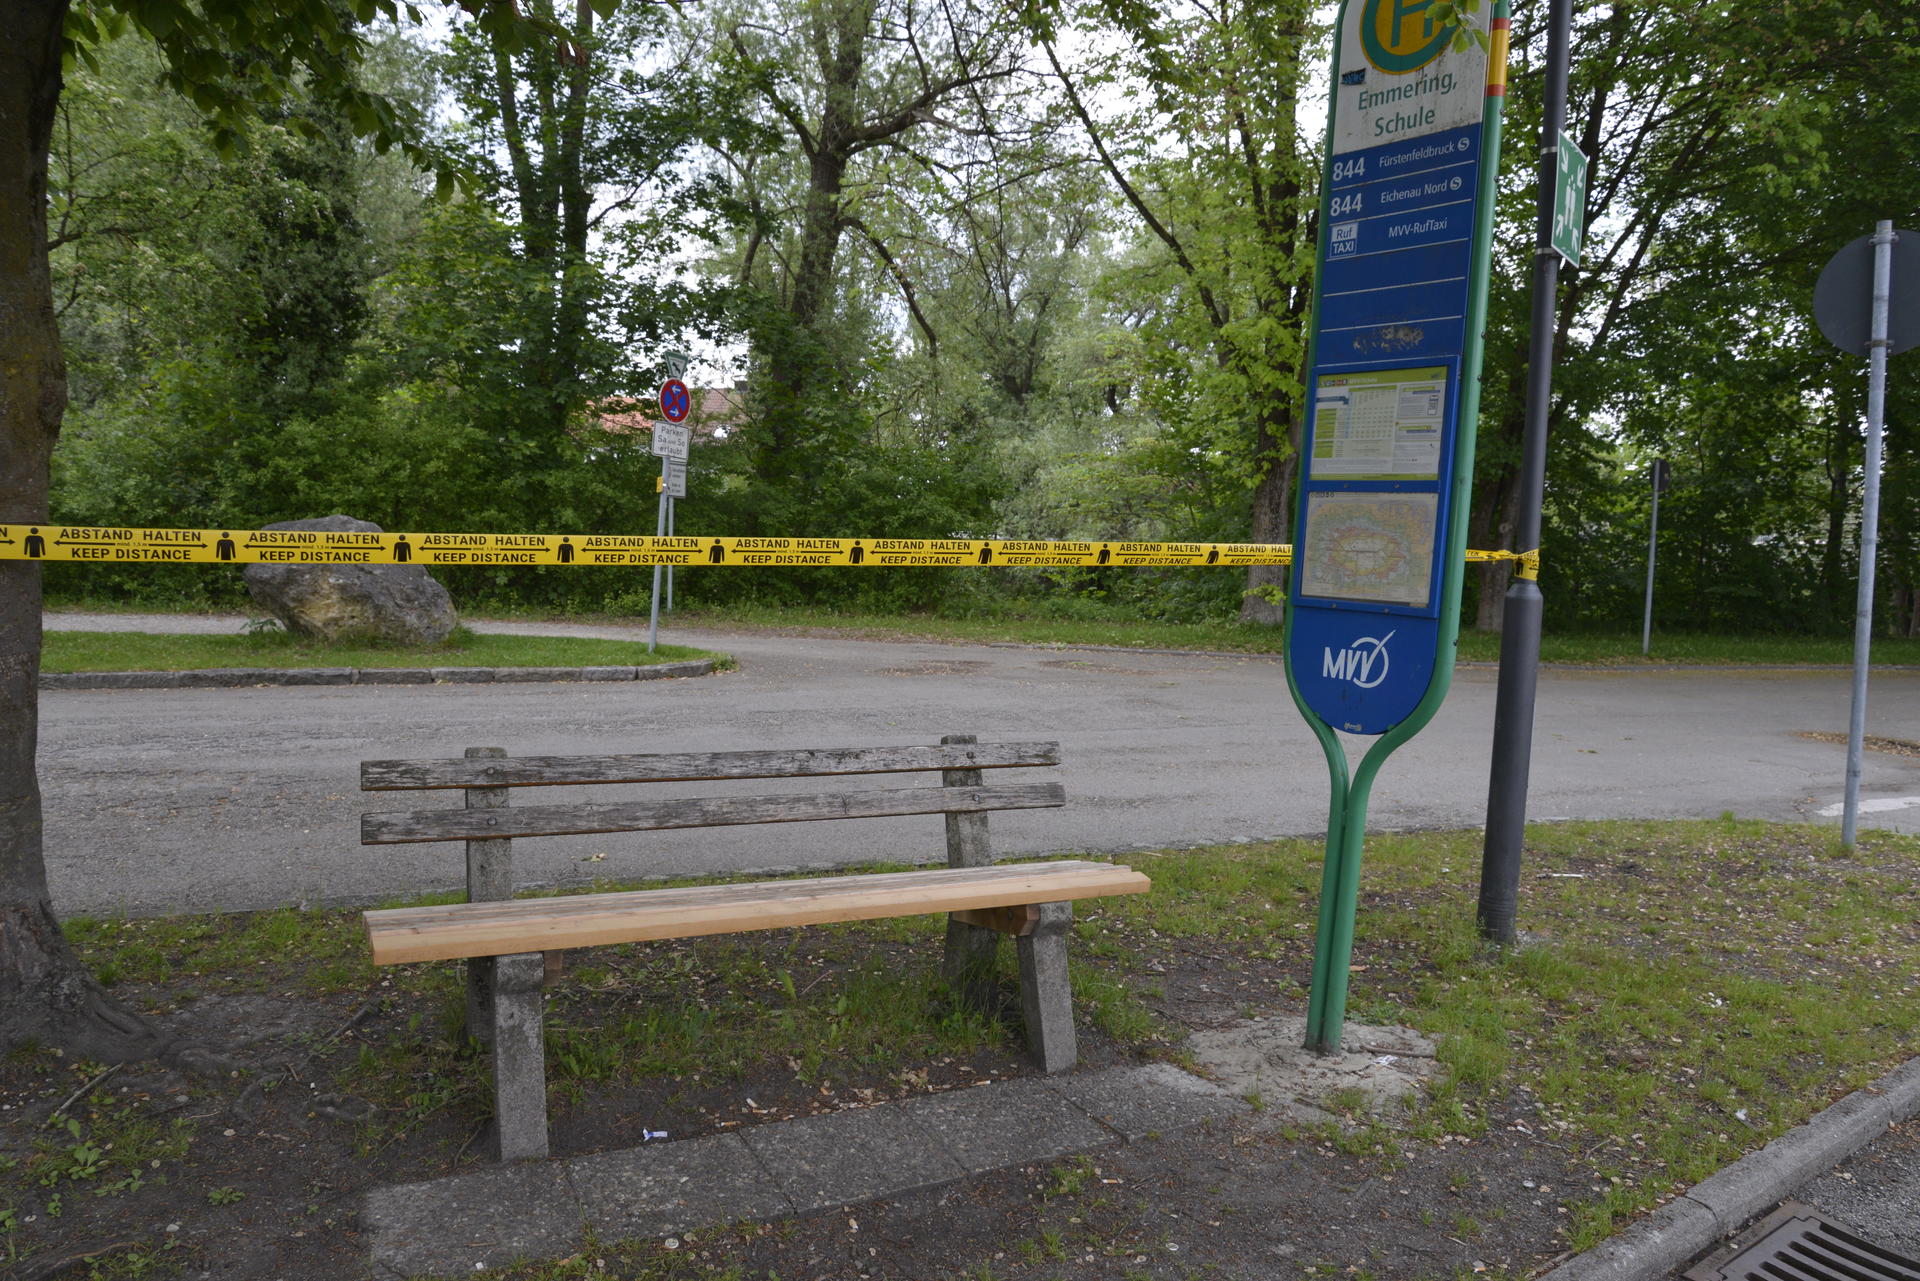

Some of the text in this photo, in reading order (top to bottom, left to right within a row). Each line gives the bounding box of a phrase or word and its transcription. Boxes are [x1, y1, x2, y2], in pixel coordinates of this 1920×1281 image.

[1358, 72, 1458, 111] Emmering,
[1374, 106, 1436, 137] Schule
[1332, 157, 1366, 181] 844
[1379, 140, 1455, 168] Fürstenfeldbruck
[1330, 192, 1363, 217] 844
[1380, 187, 1421, 204] Eichenau
[1424, 179, 1448, 195] Nord
[1336, 217, 1448, 240] Ruf MVV-RufTaxi
[1332, 240, 1355, 255] TAXI
[661, 425, 684, 437] Parken
[657, 434, 667, 444] Sa
[677, 438, 686, 447] So
[60, 528, 201, 541] ABSTAND HALTEN
[249, 532, 379, 545] ABSTAND HALTEN
[424, 535, 545, 546] ABSTAND HALTEN
[586, 537, 698, 548] ABSTAND HALTEN
[735, 538, 840, 549] ABSTAND HALTEN
[874, 540, 970, 550] ABSTAND HALTEN
[1002, 542, 1091, 551] ABSTAND HALTEN
[1120, 543, 1200, 552] ABSTAND HALTEN
[1228, 545, 1291, 553] ABSTAND HALT
[71, 547, 191, 560] KEEP DISTANCE
[260, 550, 370, 562] KEEP DISTANCE
[433, 552, 536, 563] KEEP DISTANCE
[594, 553, 689, 563] KEEP DISTANCE
[743, 555, 831, 564] KEEP DISTANCE
[880, 555, 962, 565] KEEP DISTANCE
[1007, 556, 1082, 565] KEEP DISTANCE
[1148, 557, 1193, 565] DISTANCE
[1323, 630, 1395, 688] MVV
